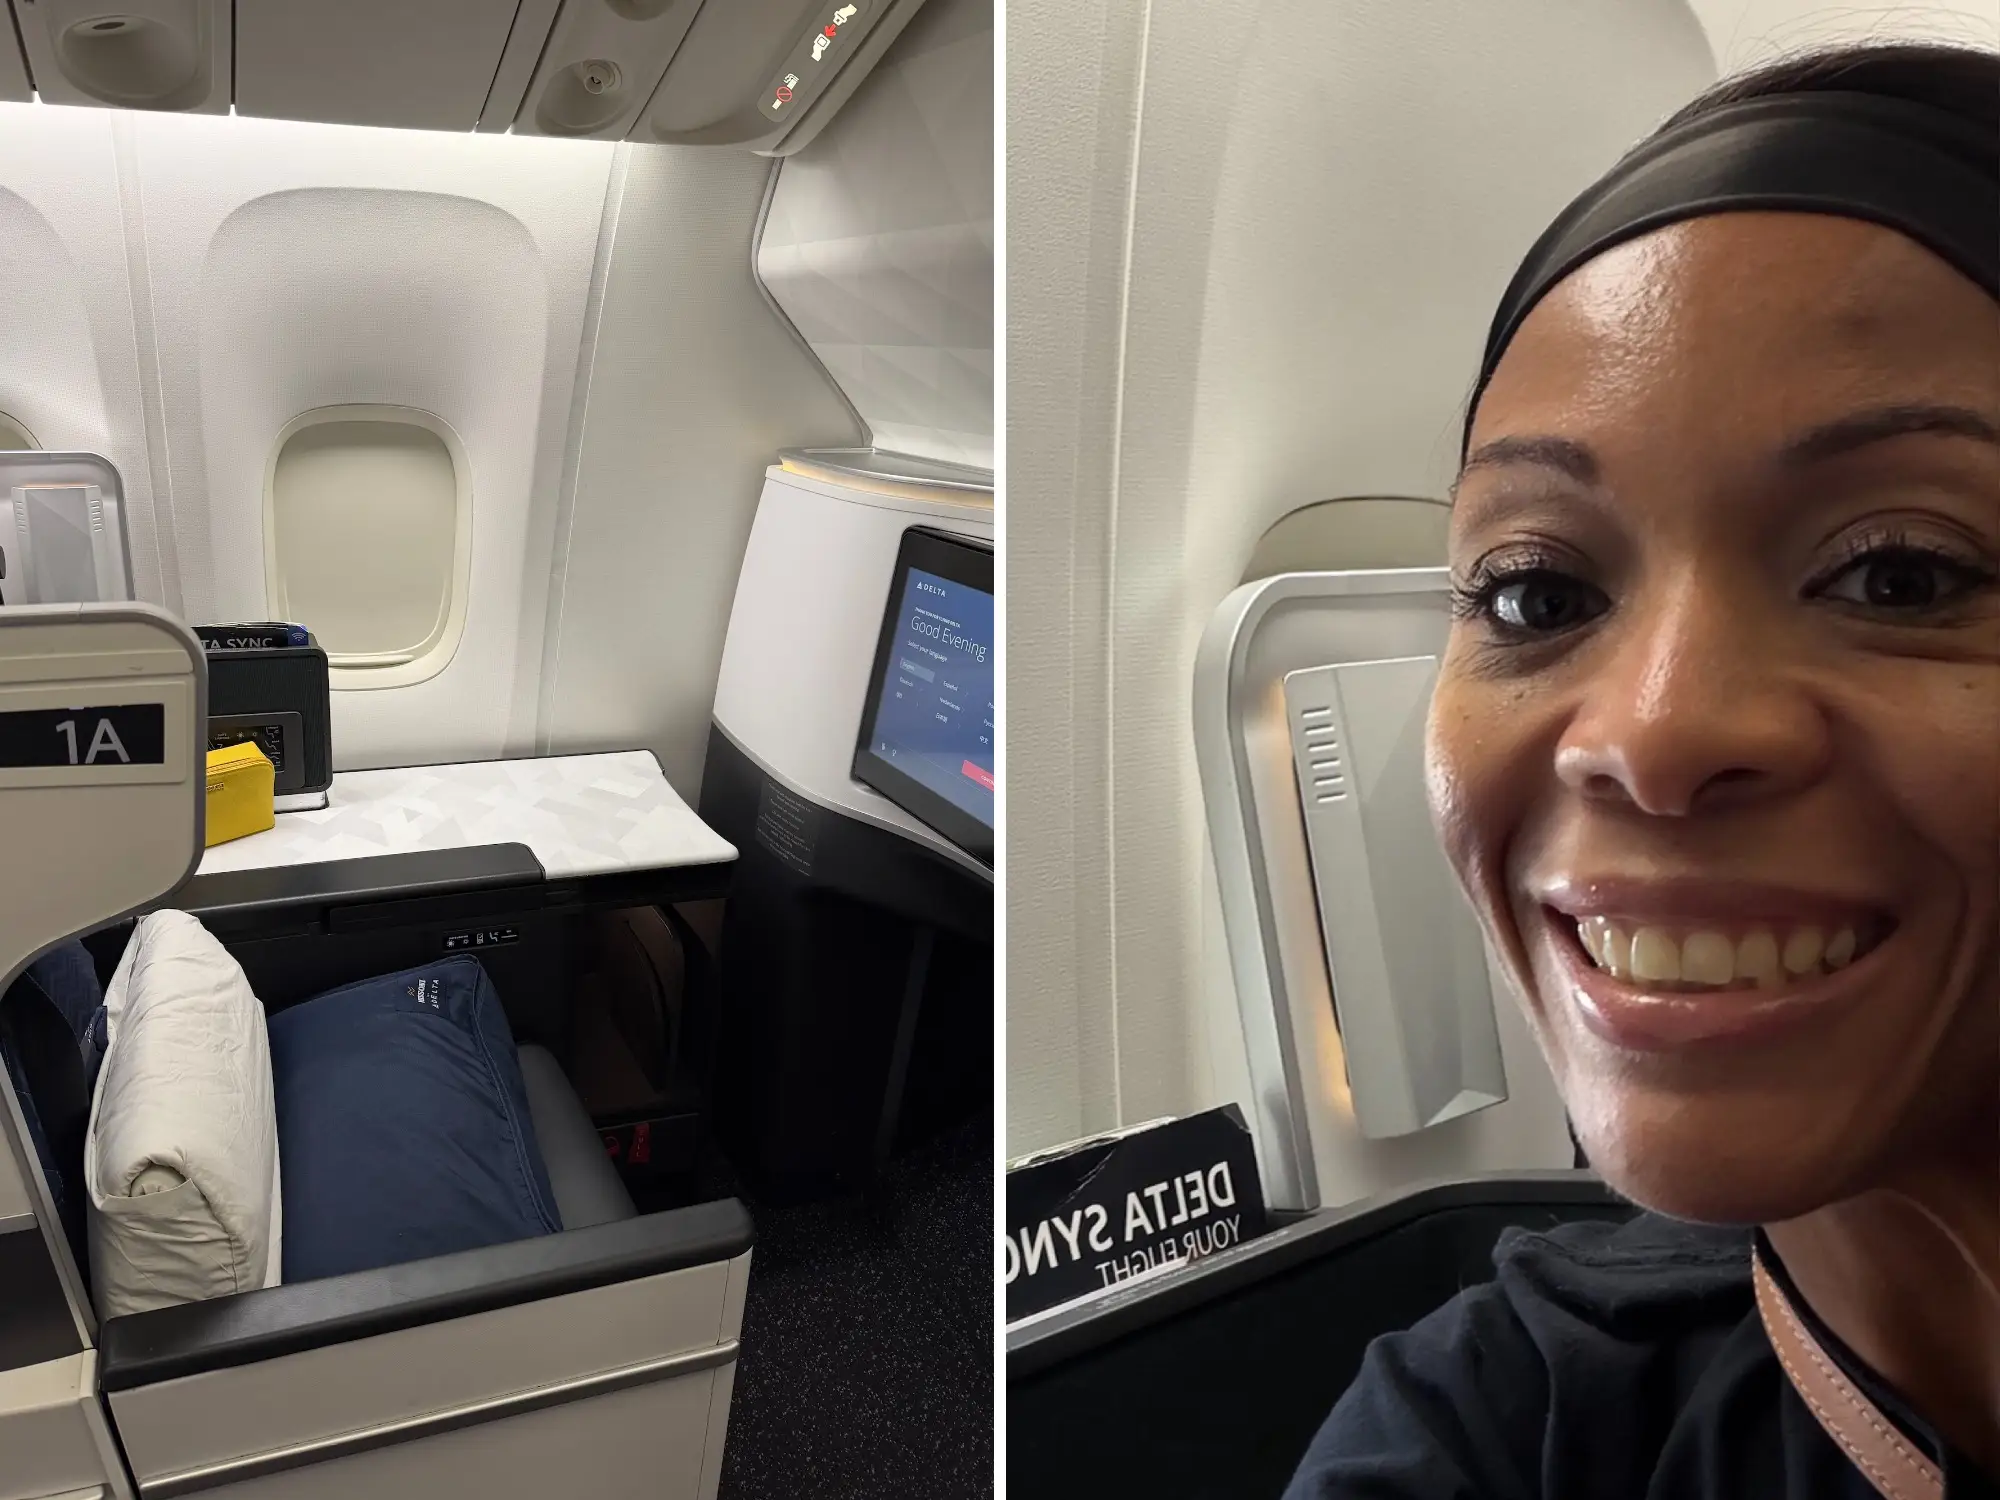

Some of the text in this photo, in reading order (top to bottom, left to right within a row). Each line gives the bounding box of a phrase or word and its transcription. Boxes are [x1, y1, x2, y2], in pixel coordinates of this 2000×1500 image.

[924, 584, 946, 597] DELTA
[911, 615, 987, 663] Good Evening
[55, 718, 131, 765] 1A
